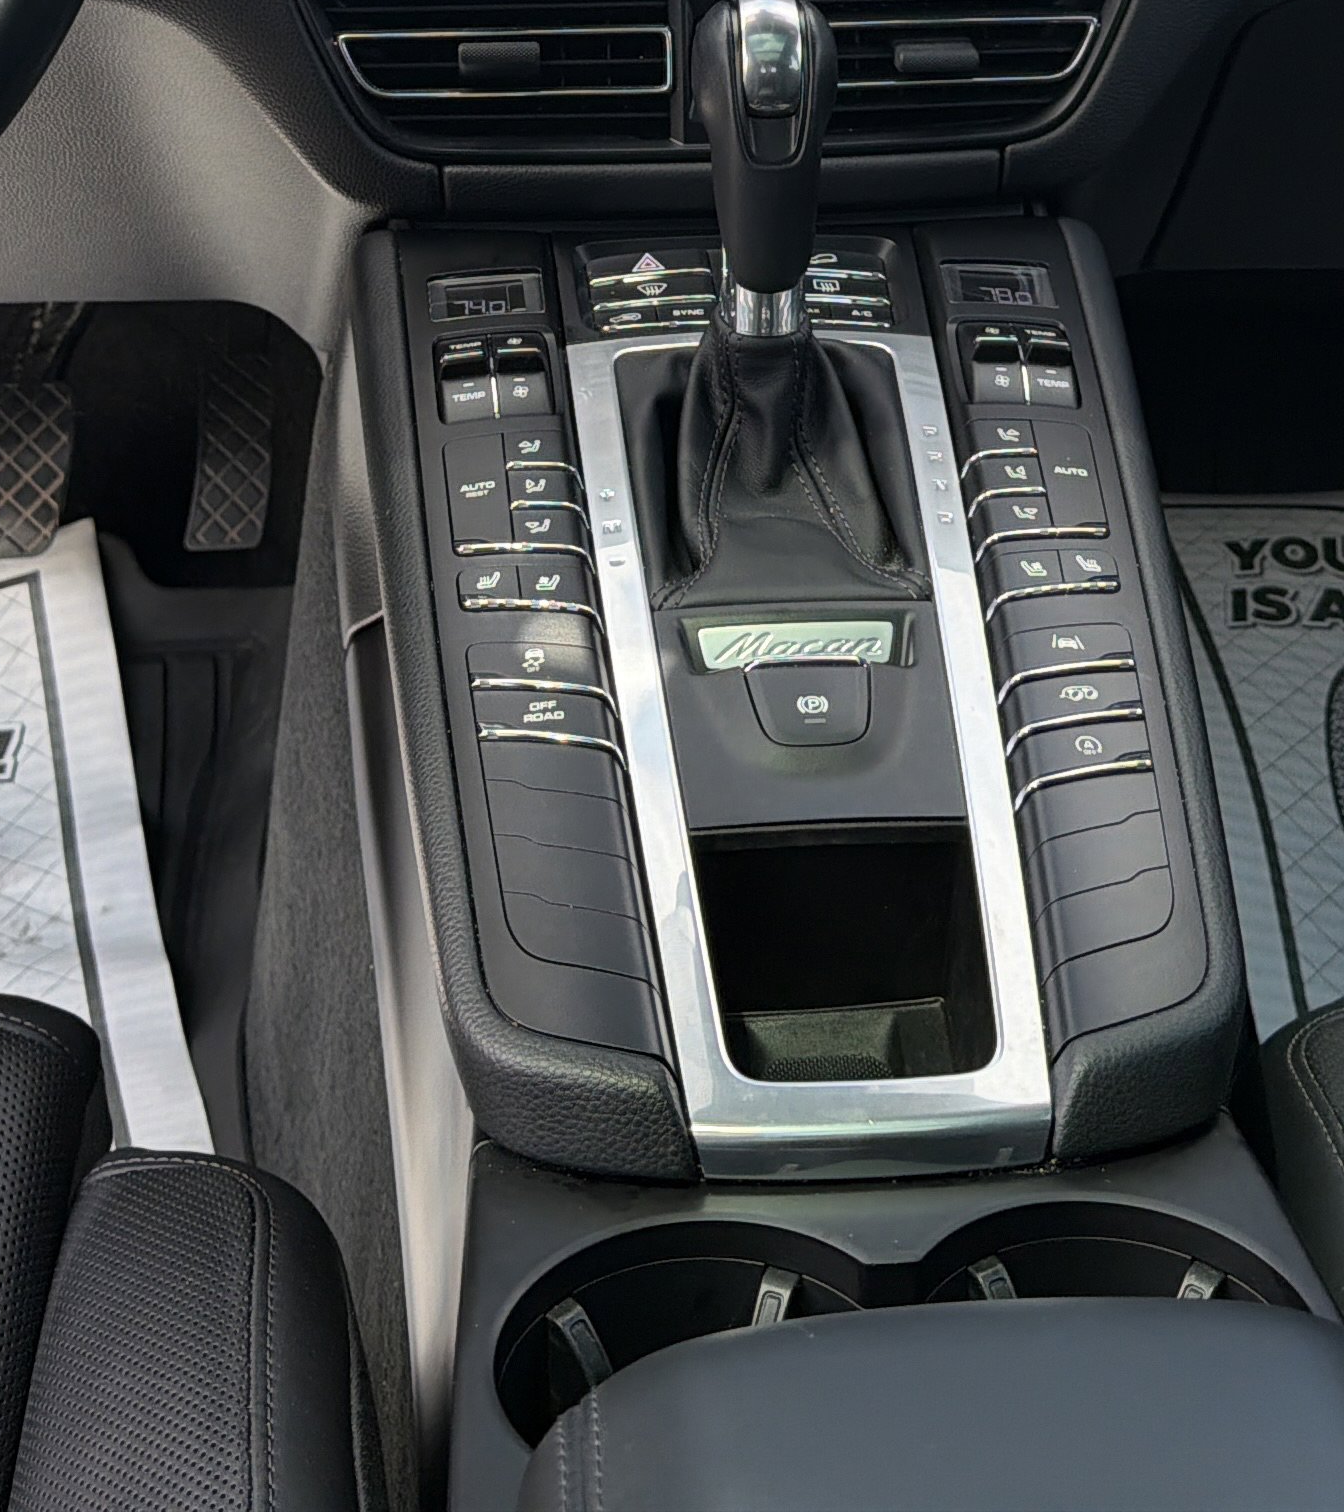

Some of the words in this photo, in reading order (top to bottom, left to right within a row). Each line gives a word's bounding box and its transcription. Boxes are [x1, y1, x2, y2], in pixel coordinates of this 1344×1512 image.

[672, 308, 704, 317] SYNC
[1037, 378, 1070, 388] TEMP
[452, 390, 486, 403] TEMP
[1054, 465, 1088, 477] AUTO
[459, 480, 496, 493] AUTO
[1230, 587, 1297, 624] IS
[714, 631, 882, 664] Macan
[529, 700, 557, 712] OFF
[523, 710, 564, 723] ROAD
